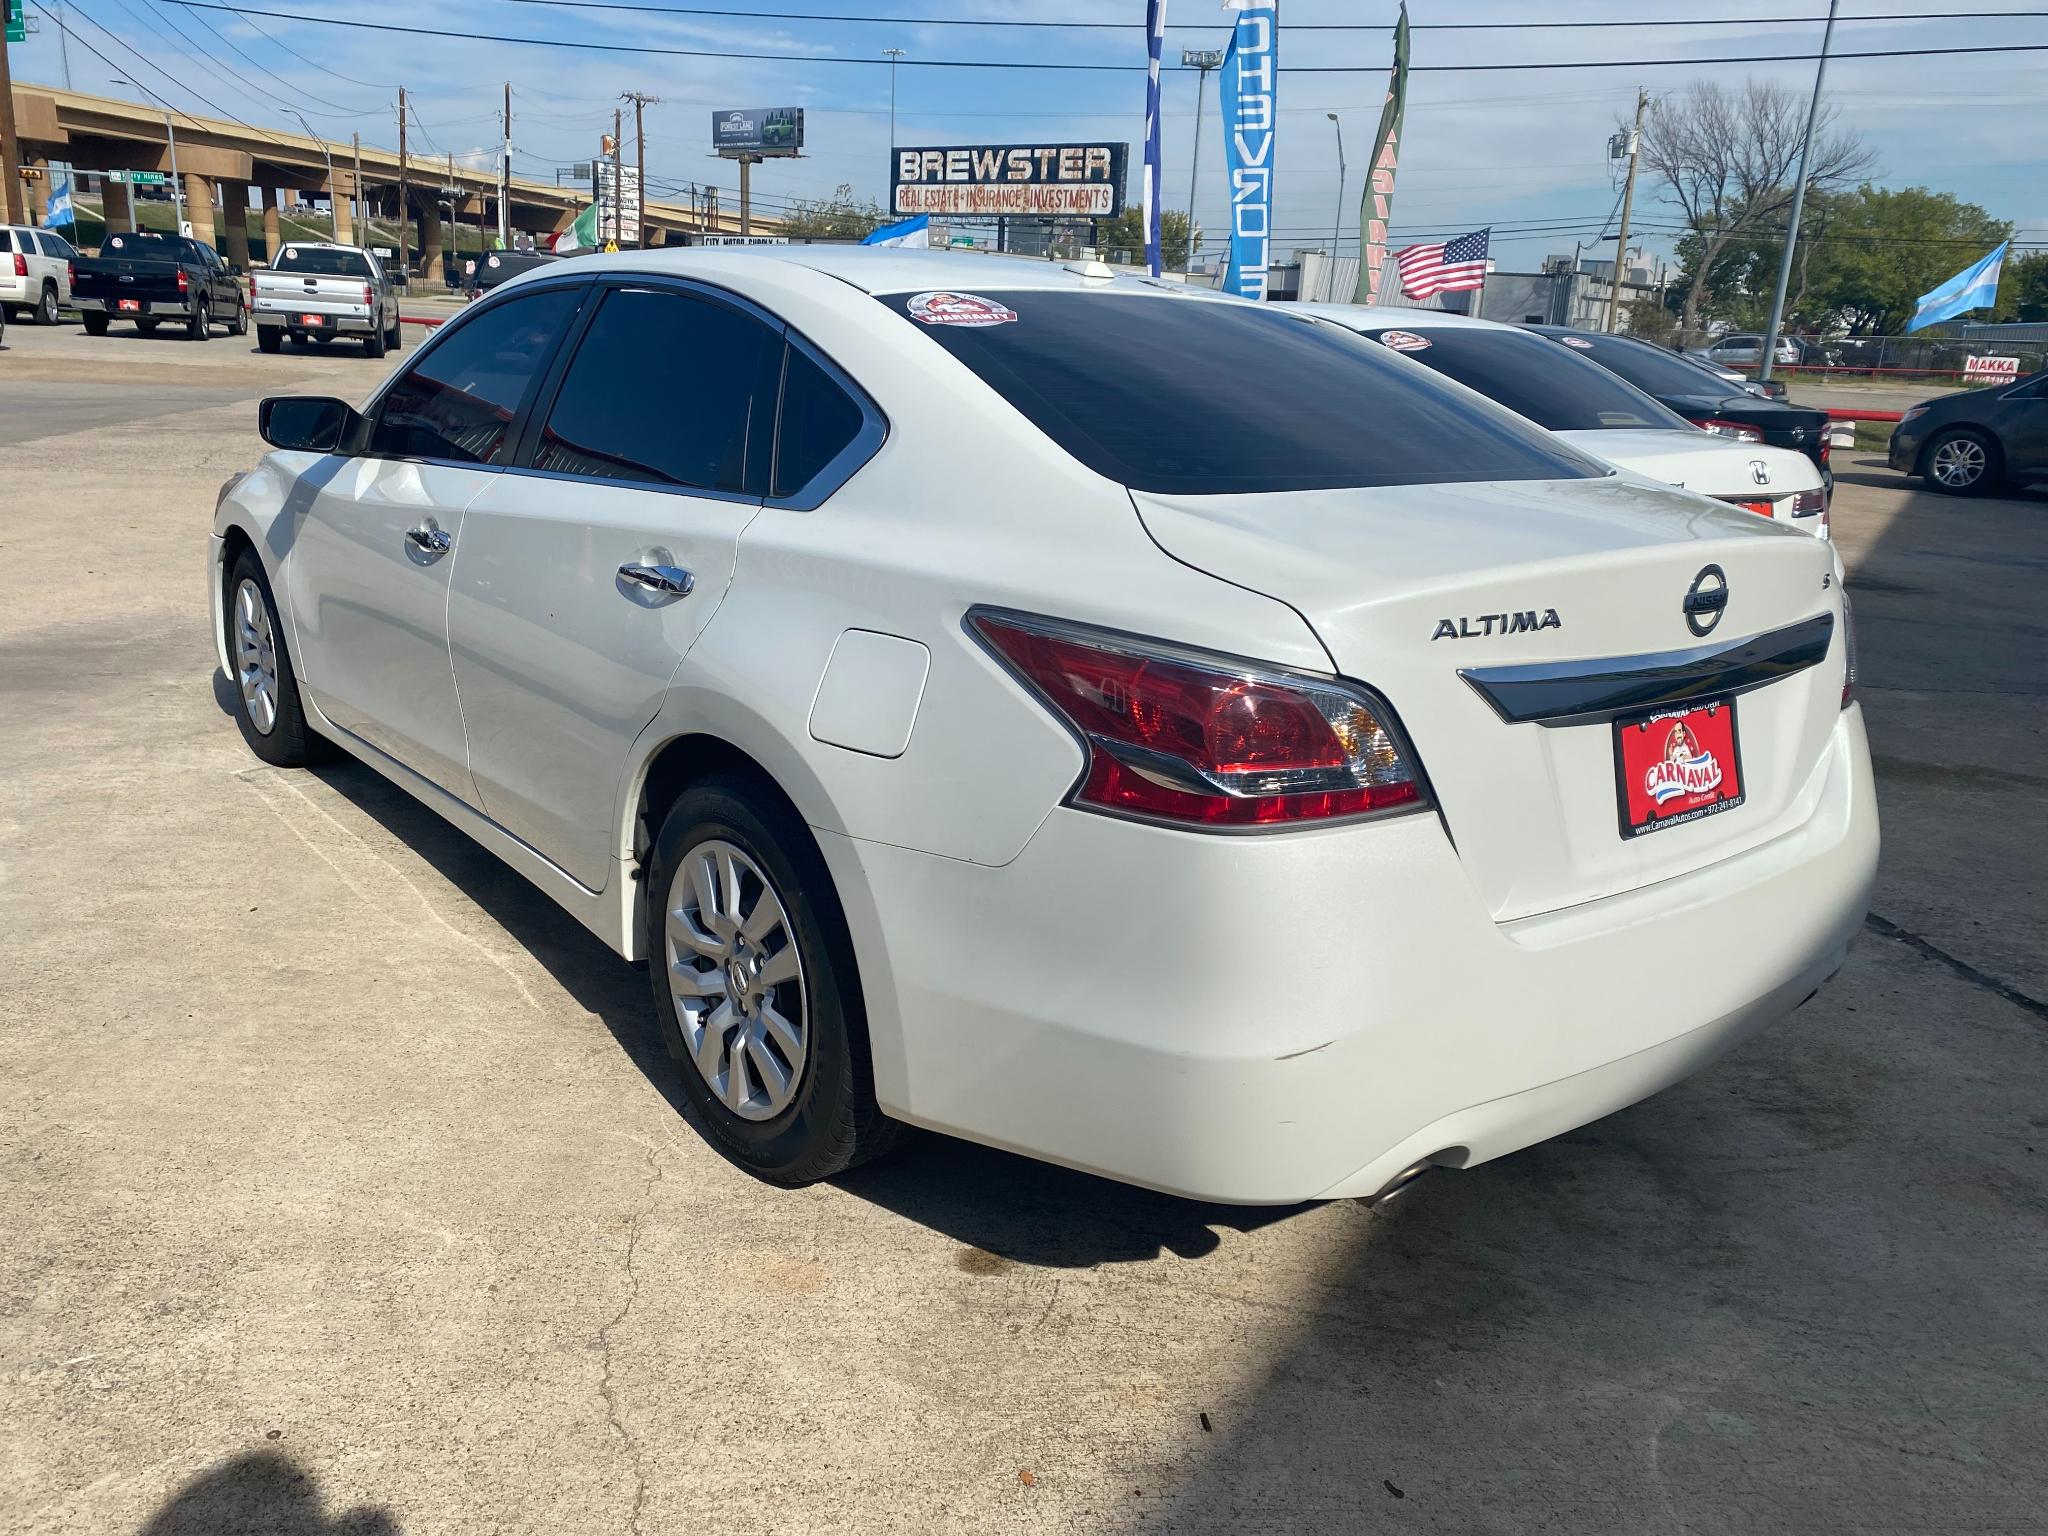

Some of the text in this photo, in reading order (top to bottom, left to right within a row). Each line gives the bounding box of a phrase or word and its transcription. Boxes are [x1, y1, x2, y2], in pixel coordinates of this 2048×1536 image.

[899, 147, 1112, 181] BREWSTER
[899, 188, 923, 207] REAL
[1029, 187, 1109, 208] INVESTMENTS
[705, 237, 719, 246] CITY
[723, 237, 745, 245] MOTOR
[748, 237, 773, 245] SUPPLY
[925, 312, 1009, 322] WARRANTY
[1968, 359, 2015, 372] MAKKA
[1821, 573, 1831, 590] S
[1431, 608, 1562, 641] ALTIMA
[1646, 760, 1721, 791] CARNAVAL
[1688, 791, 1715, 804] Auto Credit
[1635, 796, 1742, 835] www.CarnavalAutos.com 972-241-8141
